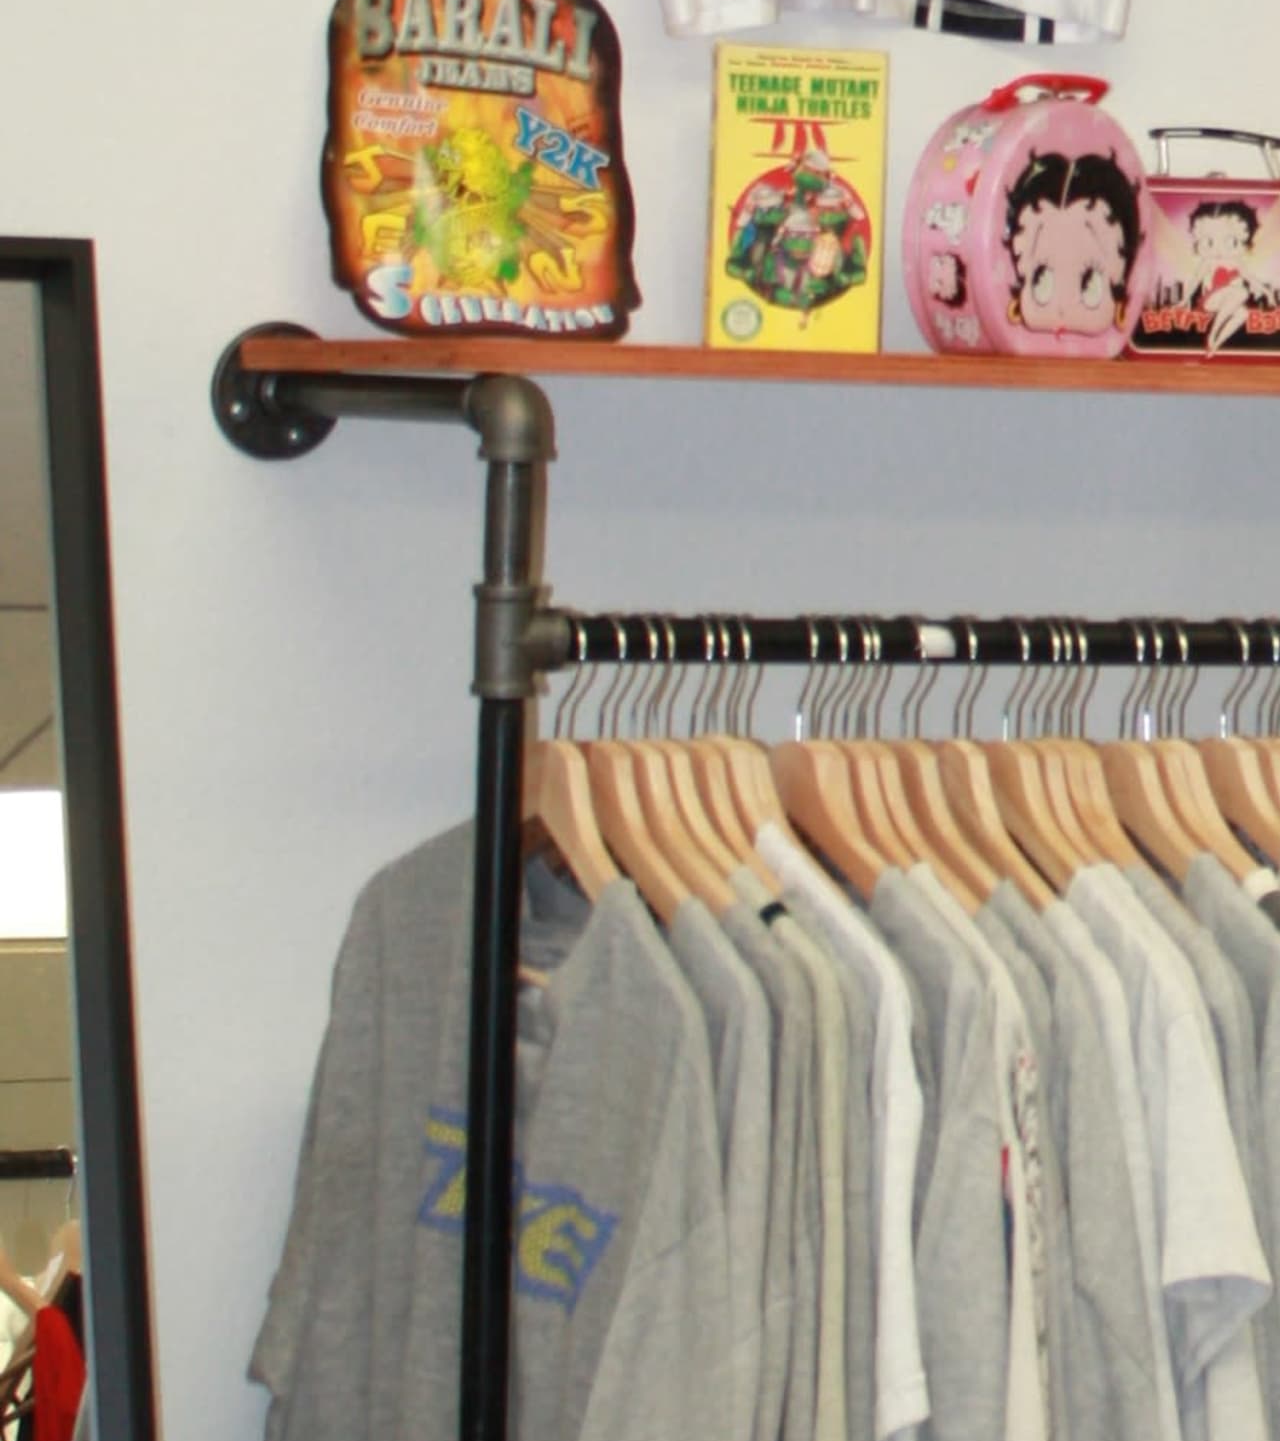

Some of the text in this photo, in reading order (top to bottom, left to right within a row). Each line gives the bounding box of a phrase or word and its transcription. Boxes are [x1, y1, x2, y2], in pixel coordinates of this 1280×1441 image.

[729, 72, 880, 100] TEENAGE MUTANT
[736, 95, 872, 119] NINJA TURTLES
[514, 104, 609, 190] Y2K
[1142, 305, 1212, 334] BETTY
